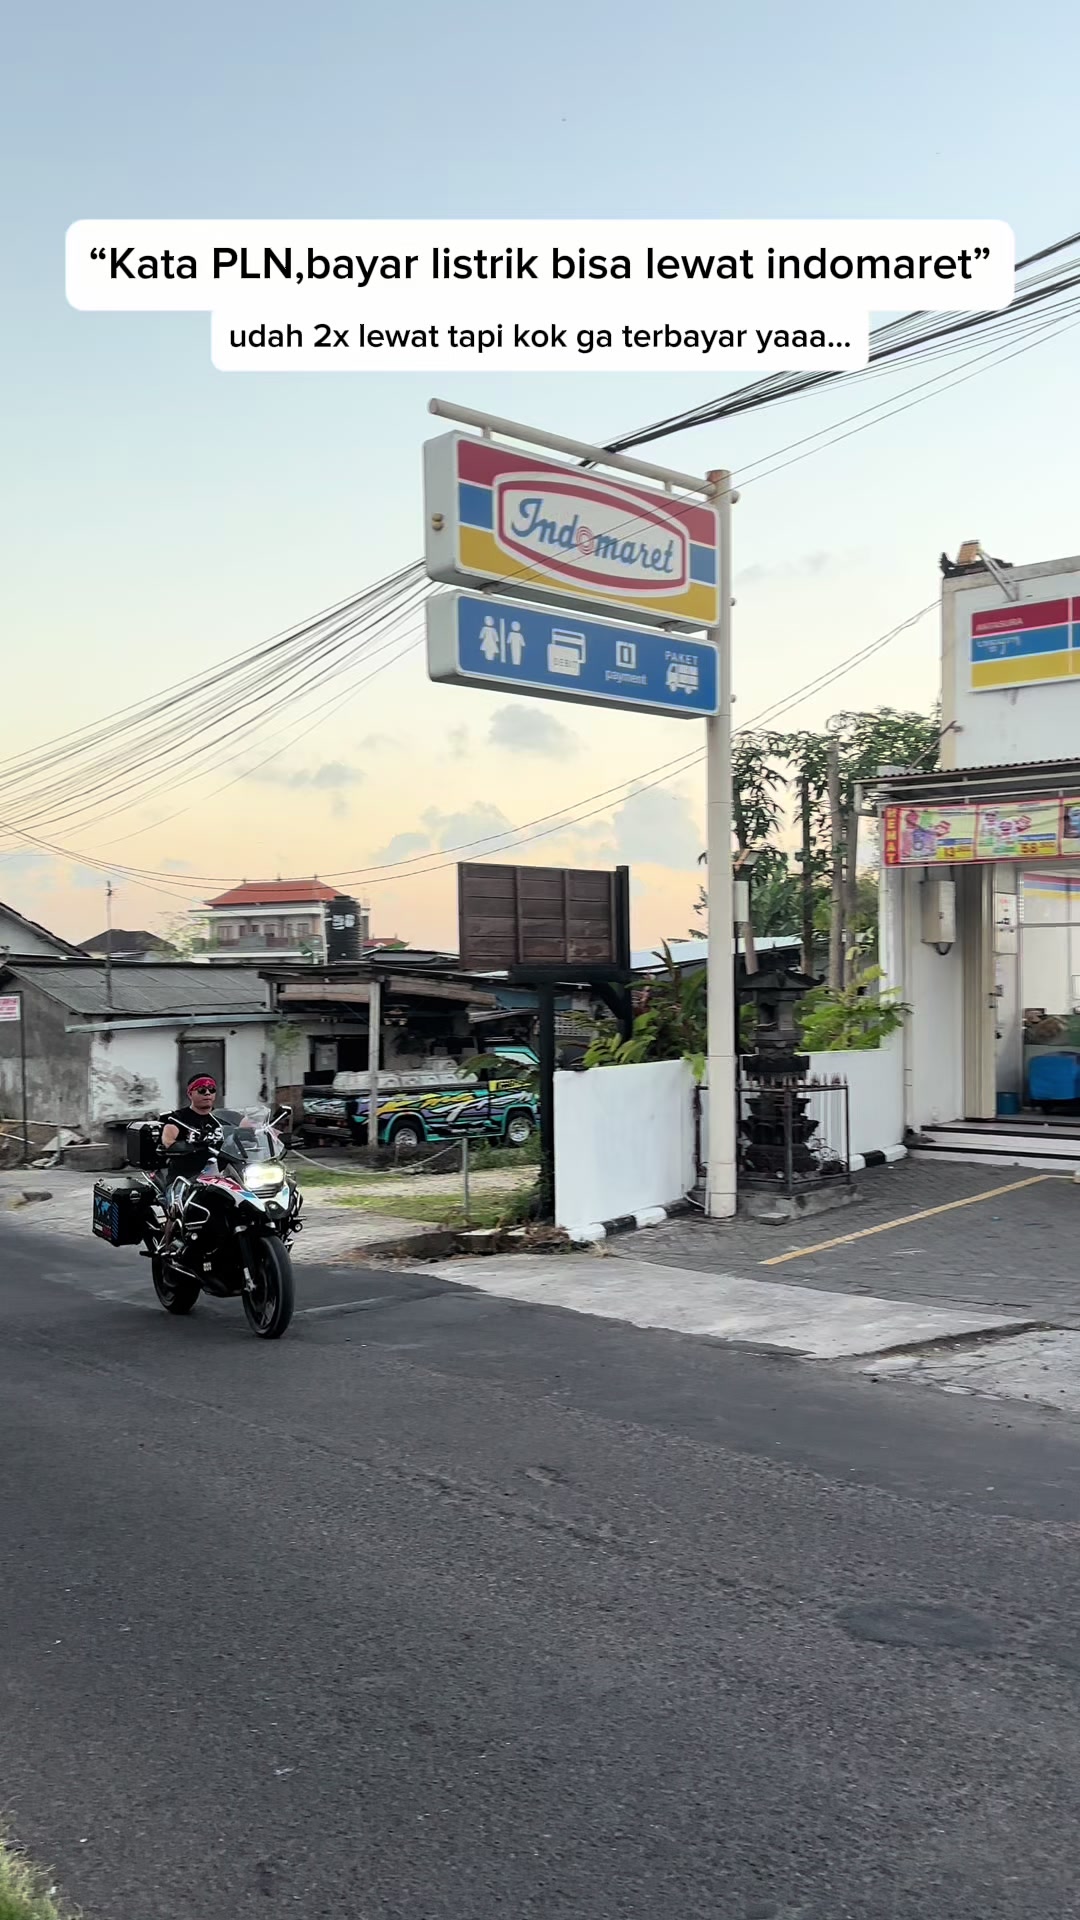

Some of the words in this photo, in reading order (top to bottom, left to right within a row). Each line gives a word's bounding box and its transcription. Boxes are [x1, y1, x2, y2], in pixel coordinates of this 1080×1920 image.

[511, 497, 674, 573] Indomaret
[664, 650, 699, 666] PAKET
[604, 669, 648, 686] payment
